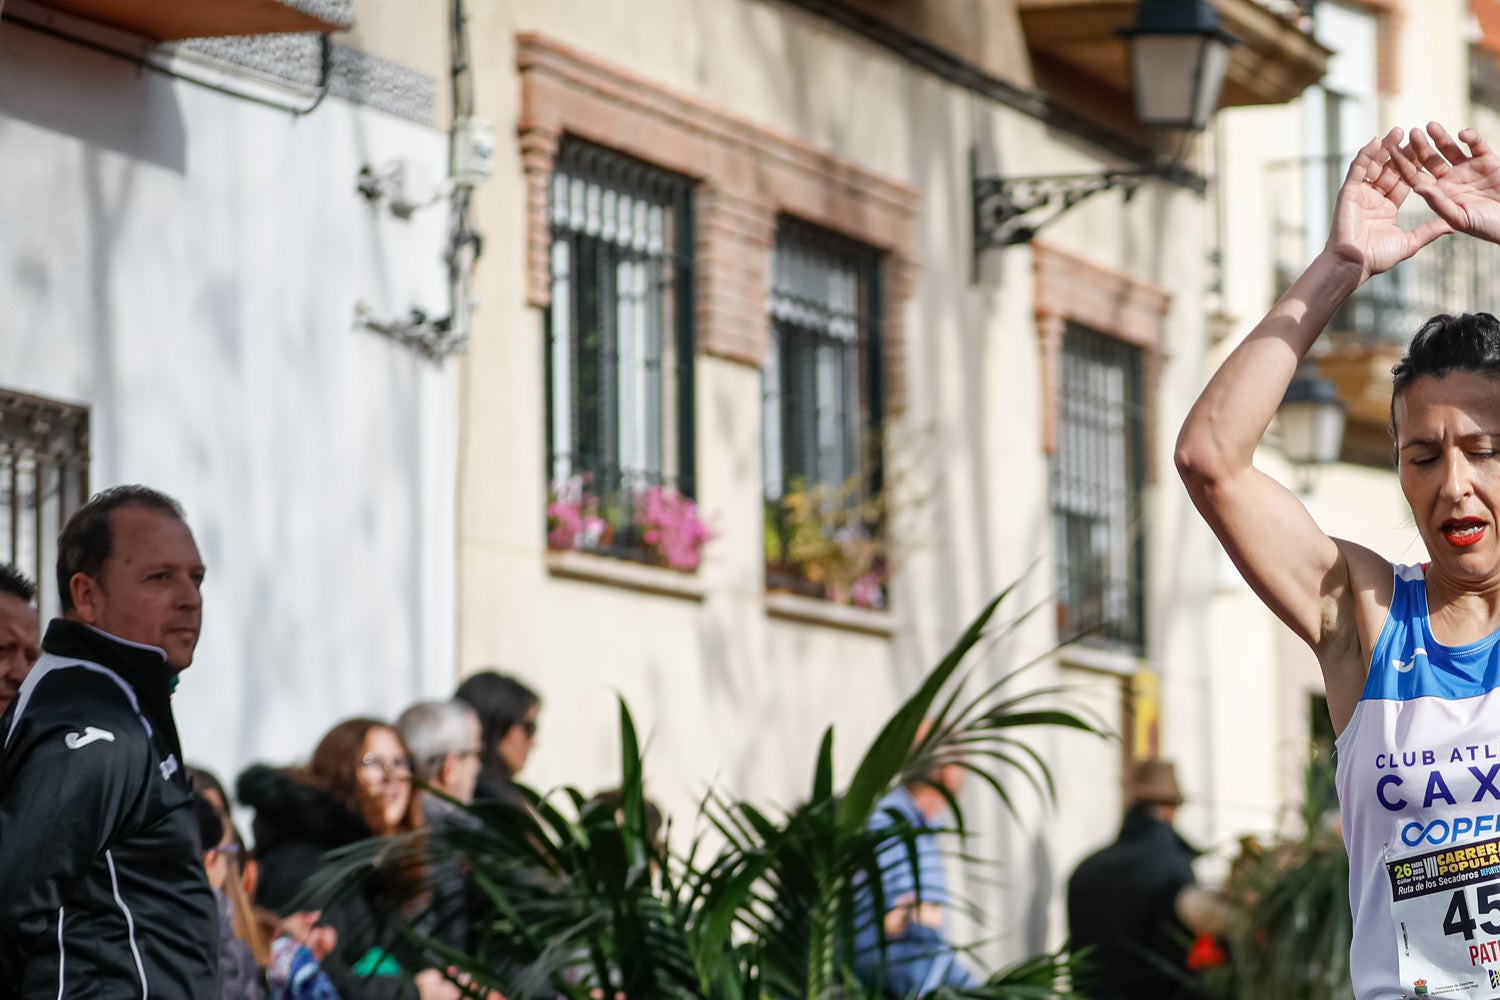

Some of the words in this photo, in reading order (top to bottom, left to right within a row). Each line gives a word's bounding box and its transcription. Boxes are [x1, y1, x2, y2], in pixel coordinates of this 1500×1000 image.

[1375, 750, 1436, 770] CLUB
[1394, 863, 1412, 879] 26
[1412, 867, 1424, 875] 2020
[1398, 885, 1414, 896] Ruta
[1415, 882, 1425, 891] de
[1425, 880, 1437, 889] los
[1438, 870, 1479, 886] Secaderos
